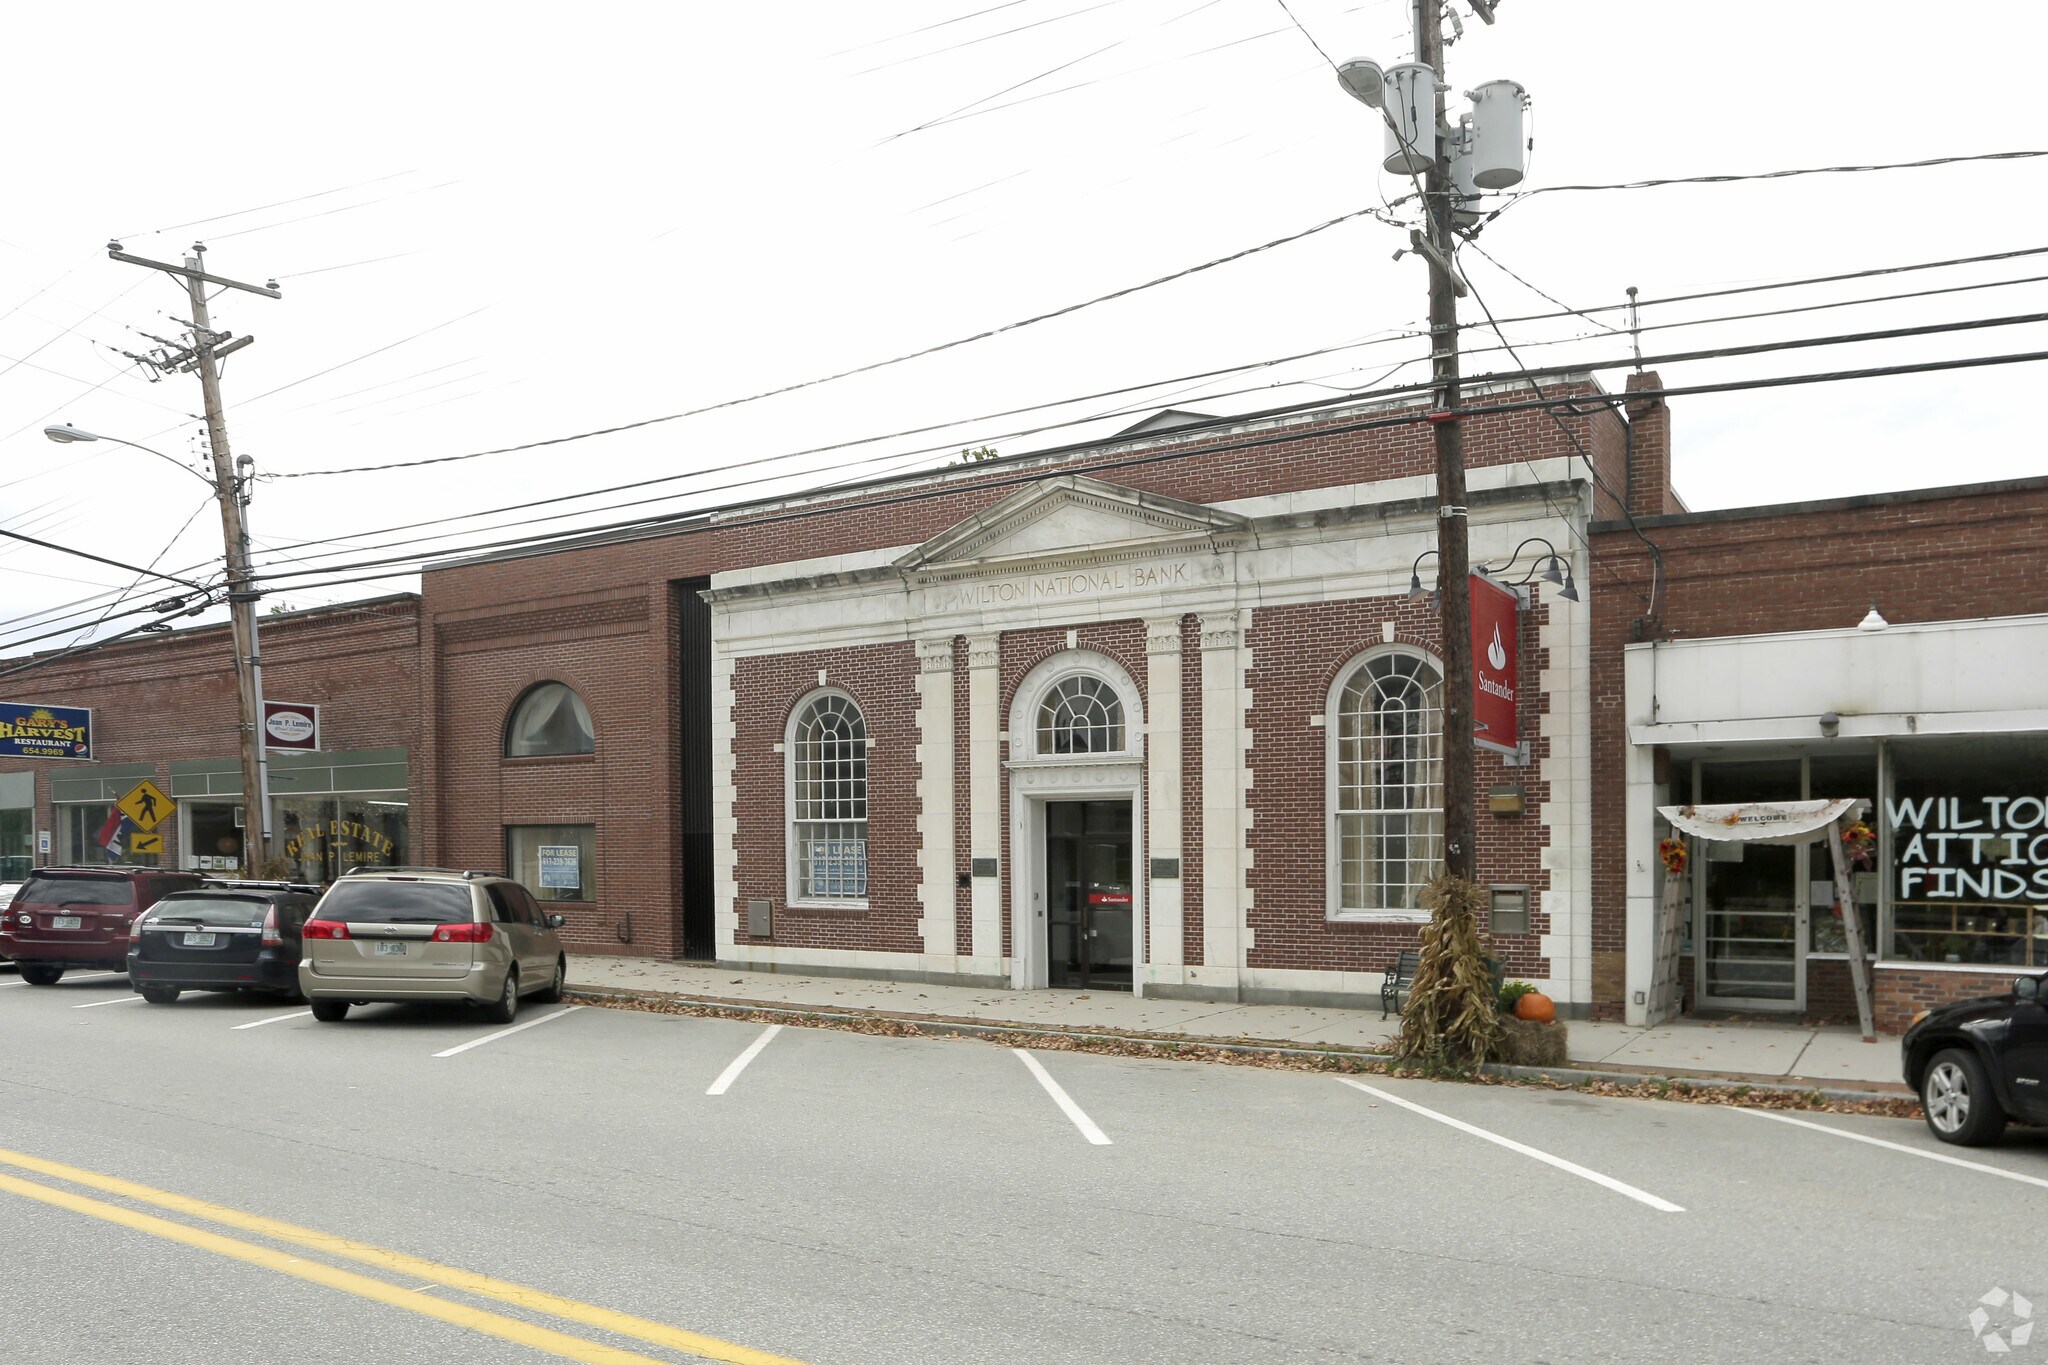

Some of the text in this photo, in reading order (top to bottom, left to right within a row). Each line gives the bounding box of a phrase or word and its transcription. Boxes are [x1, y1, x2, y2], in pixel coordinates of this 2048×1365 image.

[959, 563, 1189, 605] WILTON NATIONAL BANK
[1478, 670, 1514, 702] Santander
[0, 721, 85, 743] HARVEST
[16, 717, 68, 729] GARY'S
[14, 738, 71, 748] RESTAURANT
[23, 747, 64, 756] 654.9969
[1740, 814, 1787, 823] WELCOME
[1885, 796, 2048, 830] WILTO
[287, 820, 393, 857] REAL ESTATE
[343, 851, 379, 862] LEMIRE
[1902, 867, 2048, 899] FINDS
